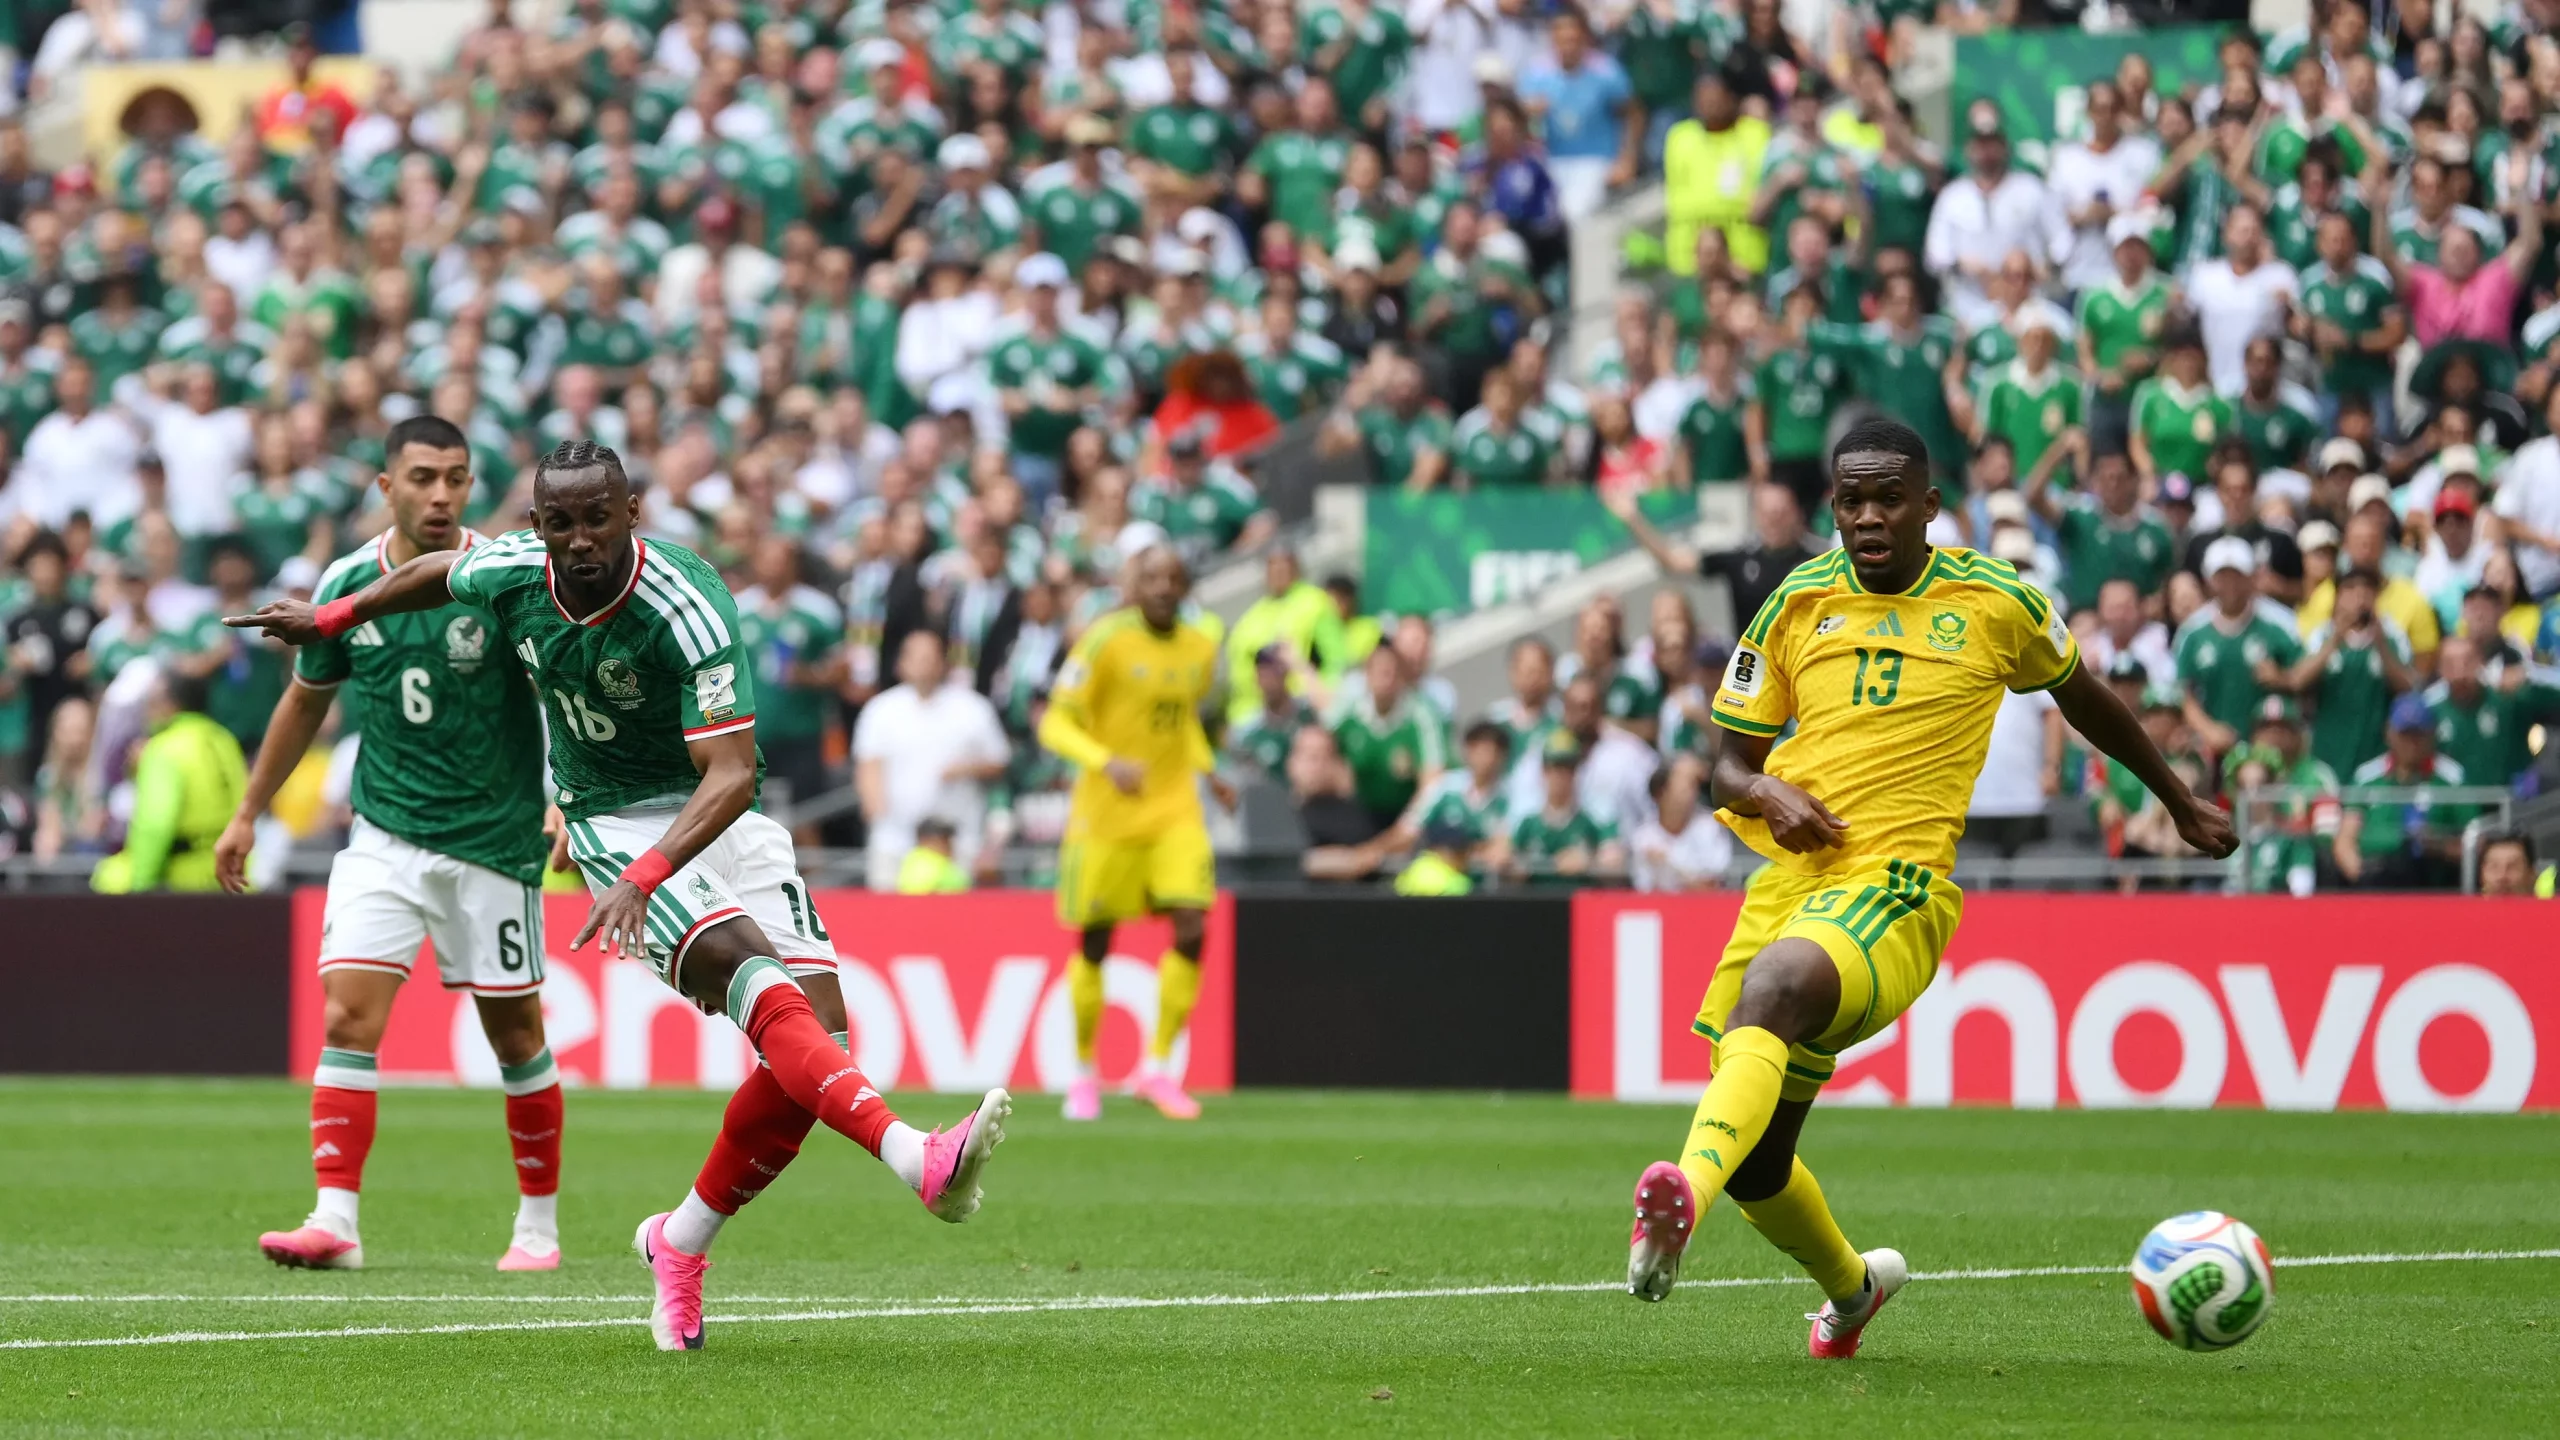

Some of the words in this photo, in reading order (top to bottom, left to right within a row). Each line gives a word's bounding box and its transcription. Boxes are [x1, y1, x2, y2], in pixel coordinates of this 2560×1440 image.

[401, 666, 434, 724] 6
[1852, 646, 1904, 706] 13
[553, 688, 617, 741] 16
[498, 918, 523, 971] 6
[376, 950, 1191, 1094] envo
[1614, 910, 2538, 1113] Lnovo
[818, 1066, 861, 1094] MÉXIC
[1697, 1118, 1737, 1142] SAFA
